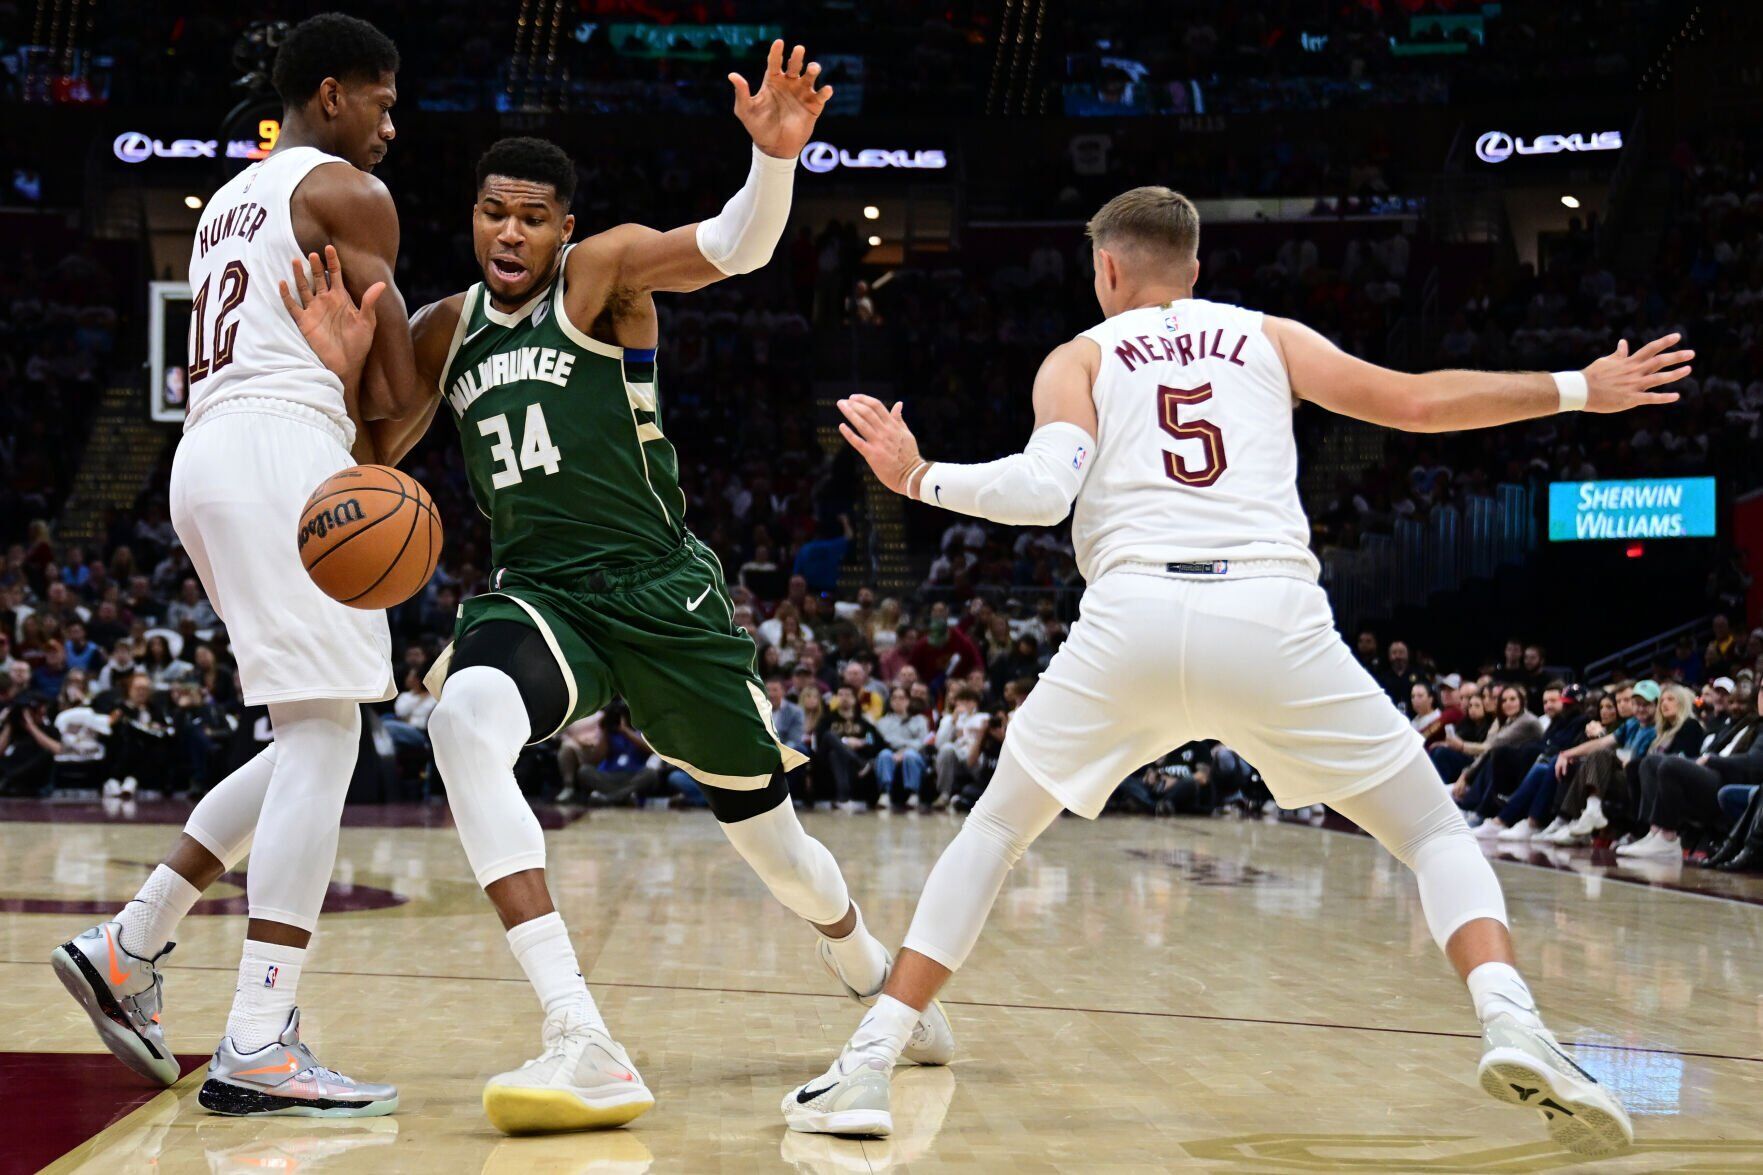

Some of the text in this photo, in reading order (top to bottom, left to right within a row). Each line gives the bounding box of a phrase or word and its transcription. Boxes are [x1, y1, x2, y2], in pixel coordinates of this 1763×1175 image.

[259, 120, 280, 150] 9
[840, 149, 947, 168] LEXUS
[1515, 131, 1623, 155] LEXUS
[200, 203, 268, 259] HUNTER
[190, 260, 249, 385] 12
[1115, 329, 1248, 372] MERRILL
[450, 347, 576, 419] MILWAUKEE
[477, 403, 562, 490] 34
[1157, 382, 1227, 488] 5
[1577, 482, 1683, 511] SHERWIN
[297, 498, 367, 552] Wilso
[1576, 511, 1684, 539] WILLIAMS
